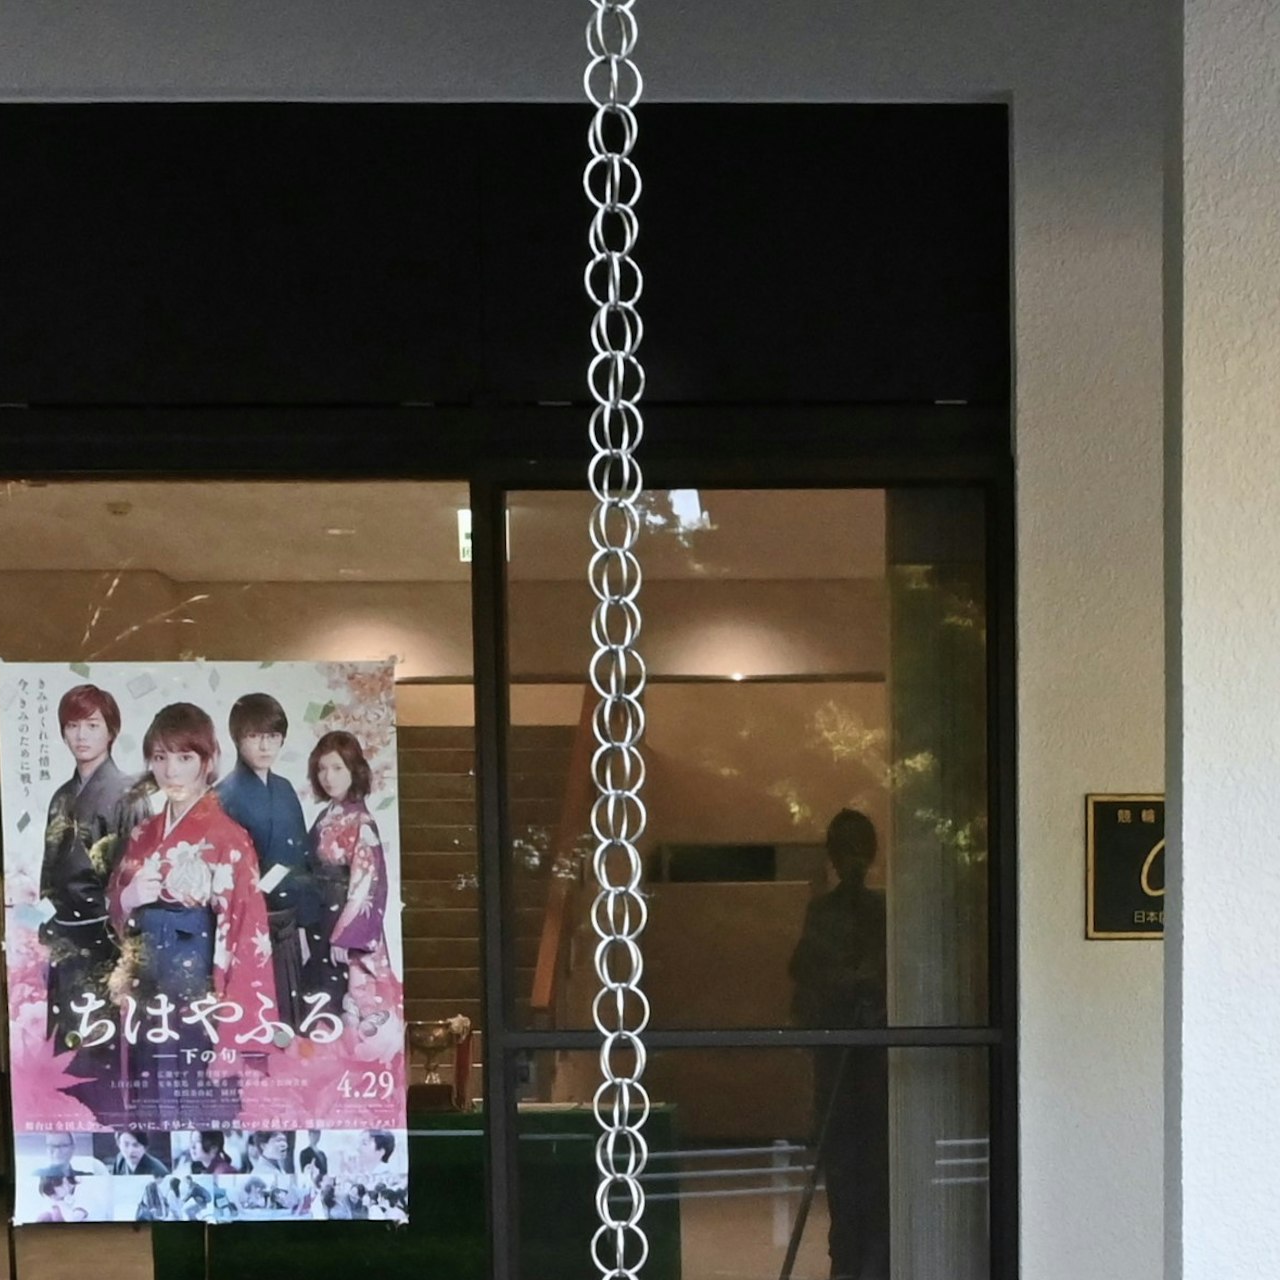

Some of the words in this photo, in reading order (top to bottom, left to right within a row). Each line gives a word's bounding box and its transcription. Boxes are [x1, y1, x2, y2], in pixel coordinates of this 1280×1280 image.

[69, 991, 345, 1049] ちはやふる
[180, 1048, 237, 1065] 下の句
[336, 1069, 395, 1101] 4.29
